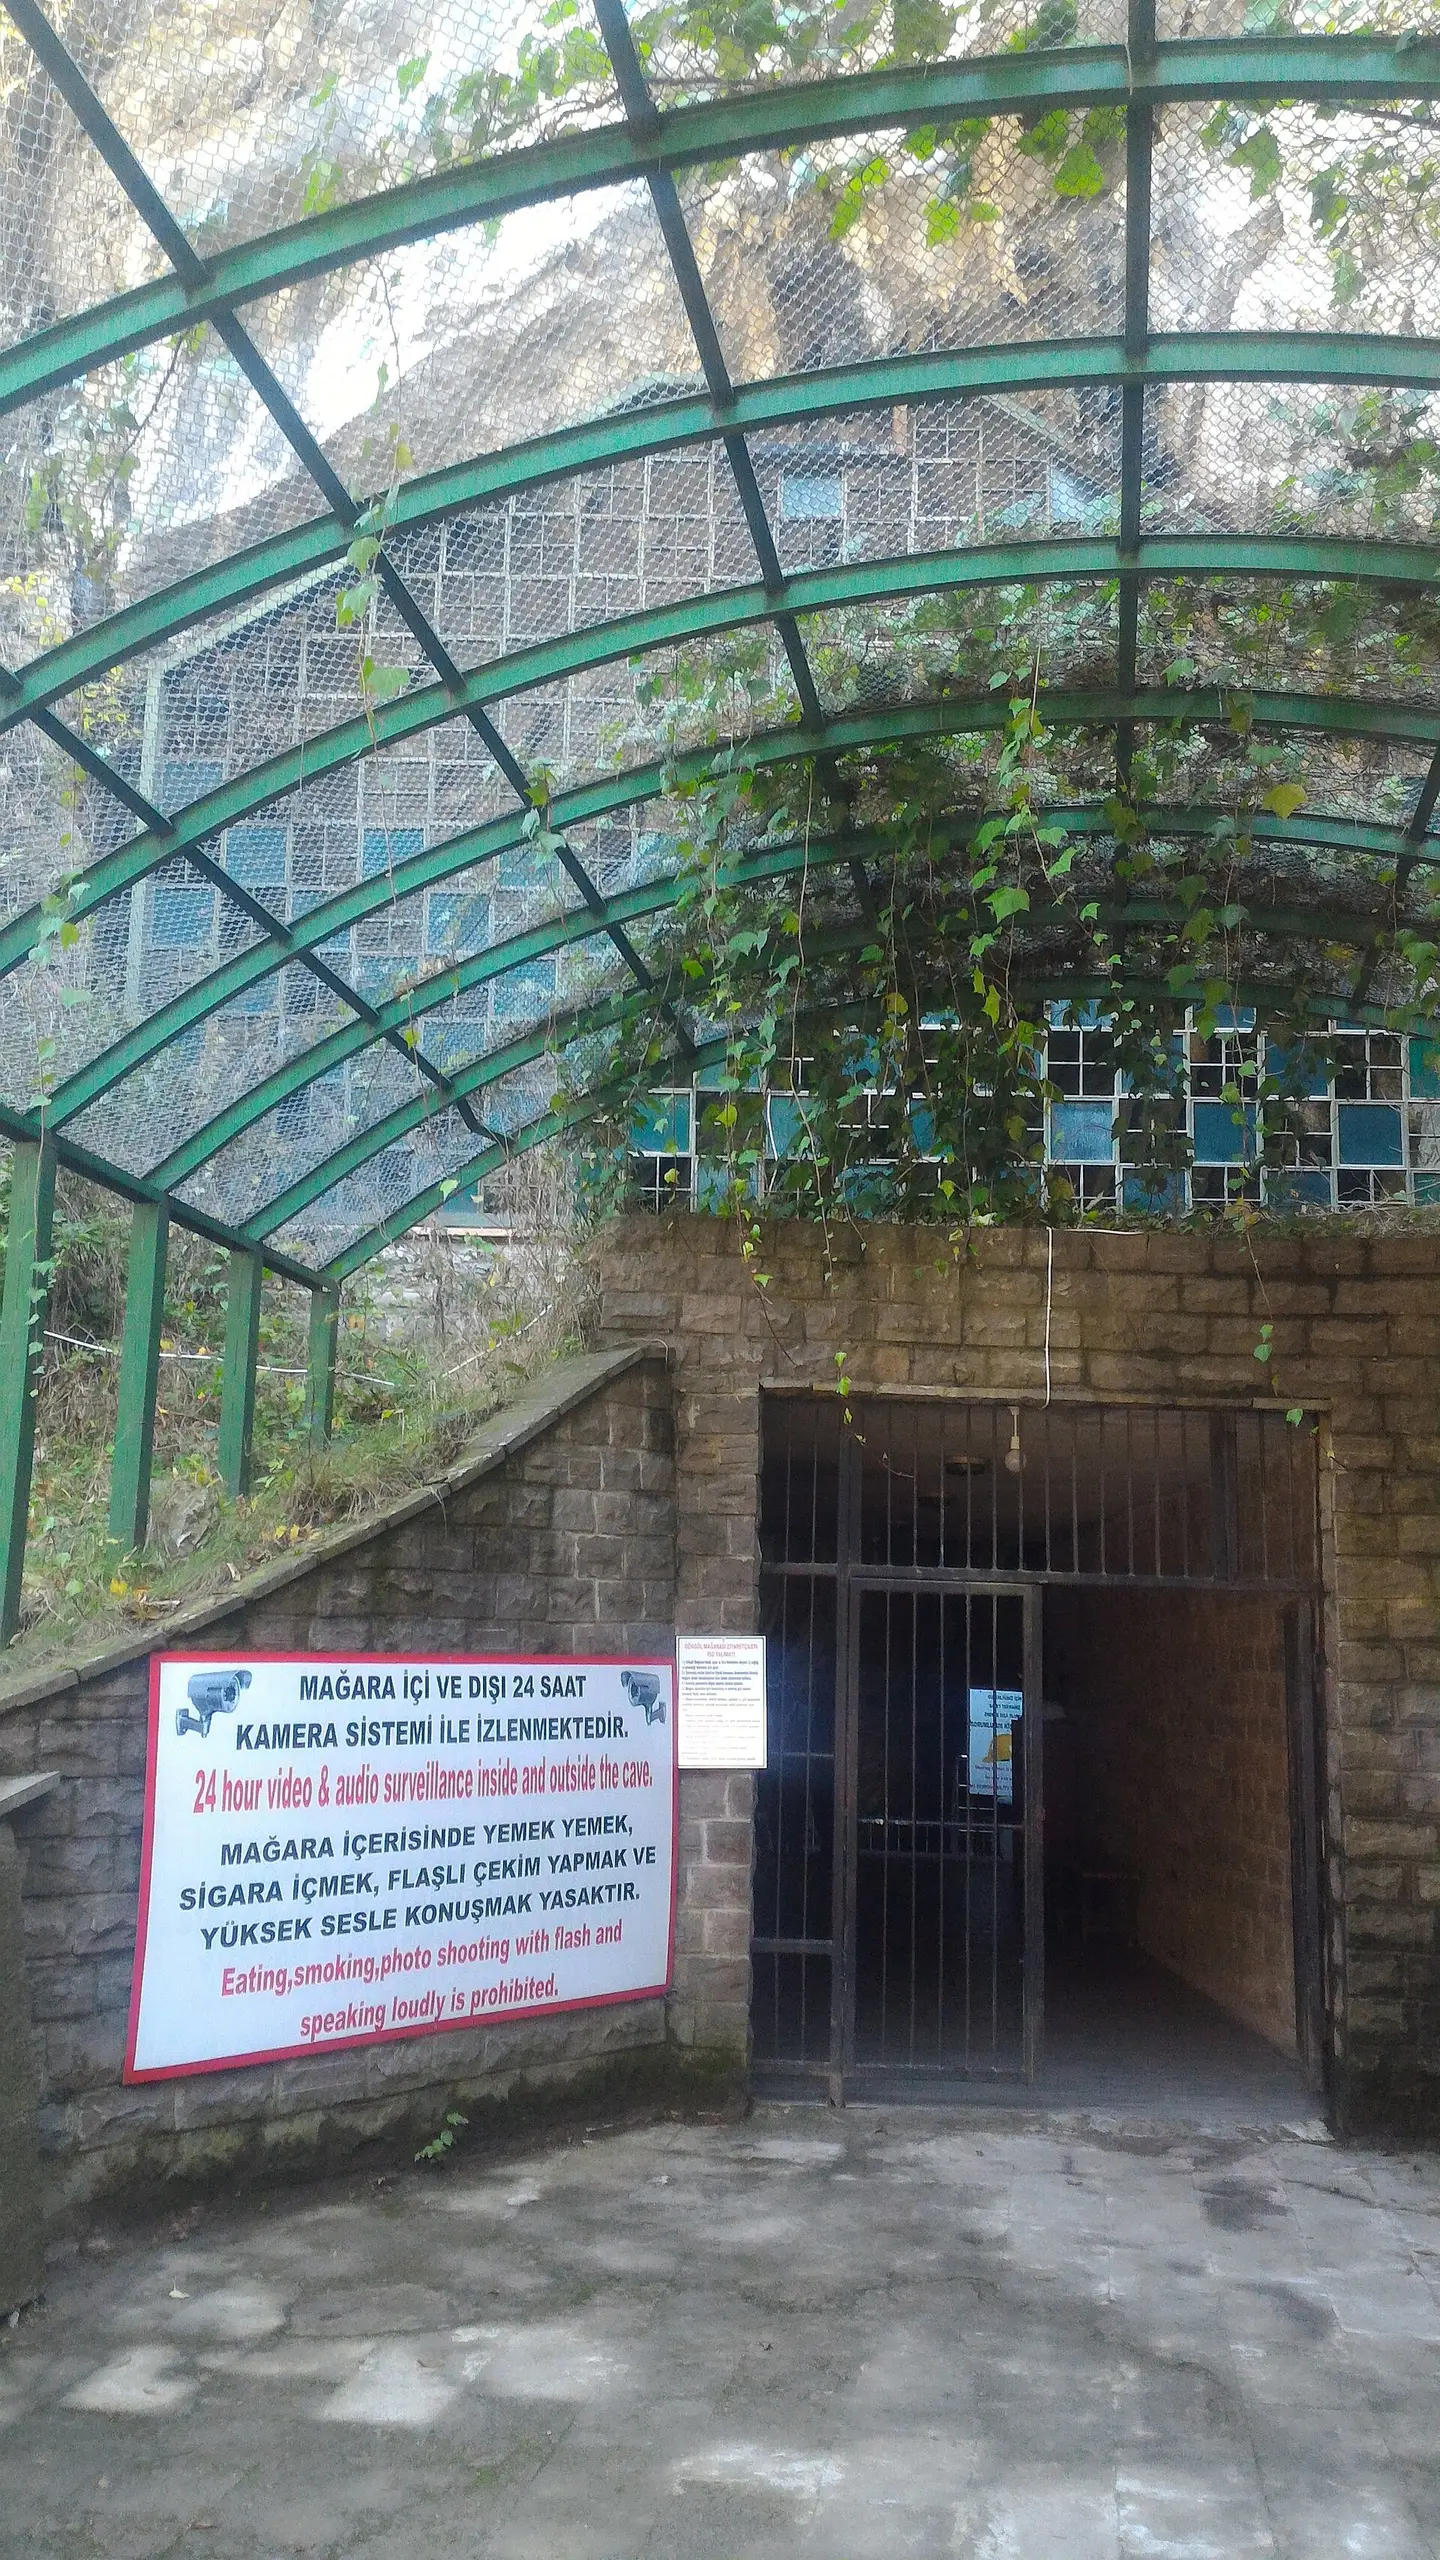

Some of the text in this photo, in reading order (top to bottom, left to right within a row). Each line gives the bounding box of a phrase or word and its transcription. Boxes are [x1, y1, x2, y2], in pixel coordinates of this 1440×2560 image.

[300, 1669, 586, 1706] MAĞARA İÇİ VE DIŞI 24 SAAT
[236, 1710, 628, 1750] KAMERA SİSTEMİ İLE İZLENMEKTEDİR.
[193, 1754, 652, 1813] 24 hour video & audio surveillance inside and outside the cave.
[221, 1812, 632, 1866] MAĞARA İÇERİSİNDE YEMEK YEMEK,
[179, 1845, 656, 1910] SİGARA İÇMEK, FLAŞLI ÇEKİM YAPMAK VE
[200, 1880, 639, 1950] YÜKSEK SESLE KONUŞMAK YASAKTIR.
[437, 1934, 510, 1967] shooting
[515, 1928, 549, 1956] with
[554, 1923, 591, 1951] flash
[596, 1918, 622, 1947] and
[300, 1973, 559, 2041] speaking loudly is prohibited.
